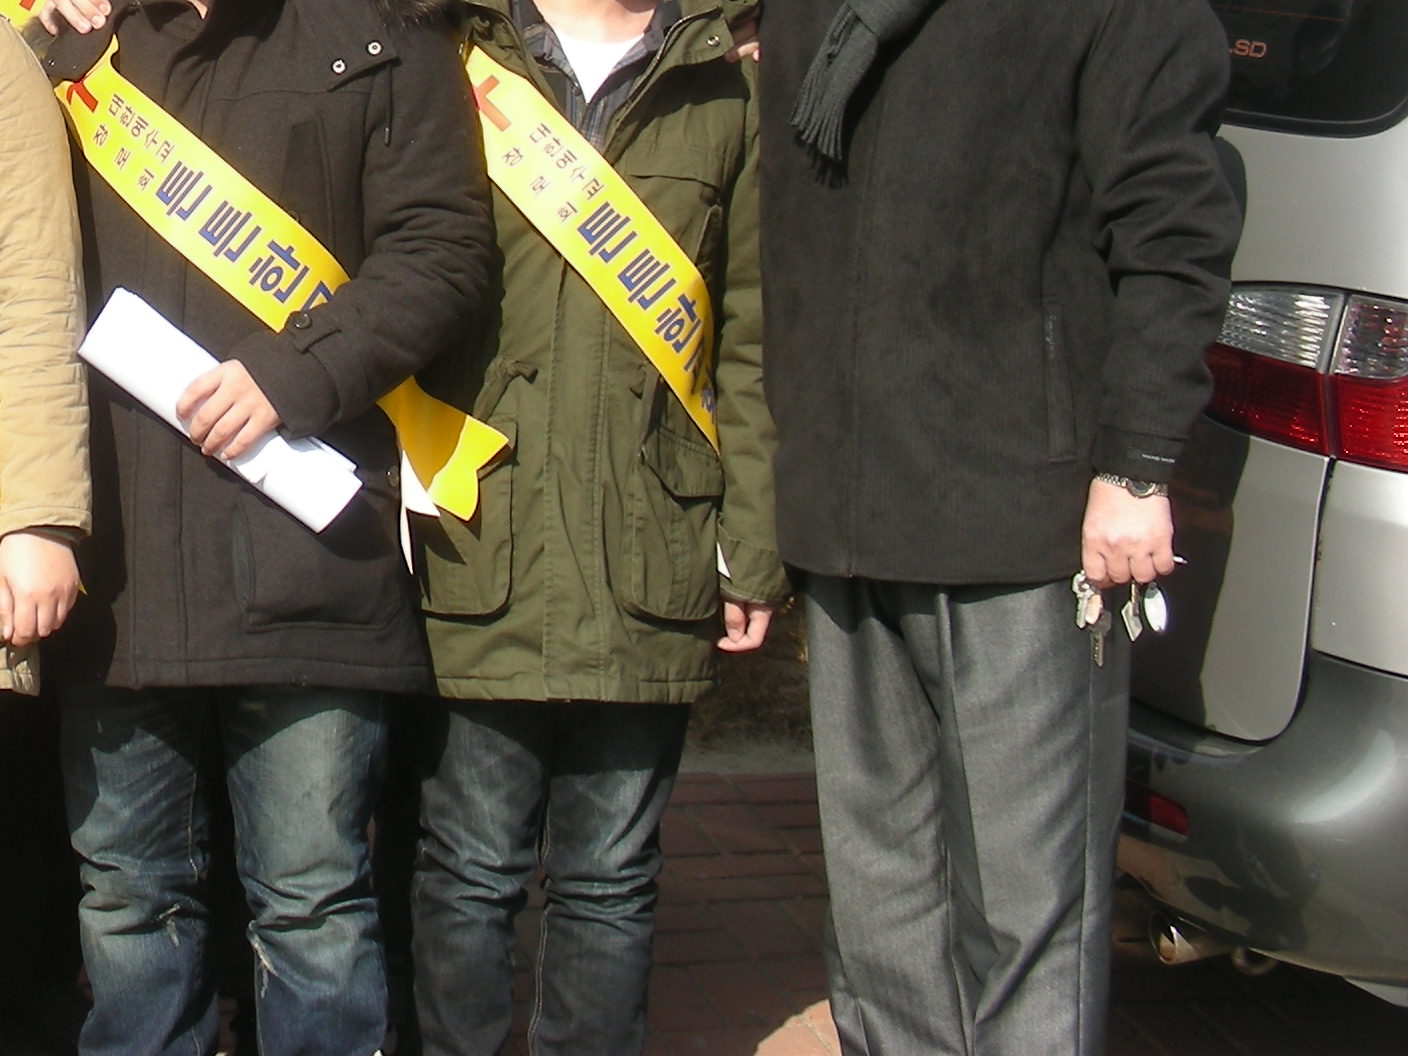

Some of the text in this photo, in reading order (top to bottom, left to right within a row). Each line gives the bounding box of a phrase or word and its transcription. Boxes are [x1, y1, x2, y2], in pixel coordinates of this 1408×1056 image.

[1229, 39, 1267, 58] SD
[109, 93, 175, 163] 대한예수교
[529, 122, 605, 201] 대한예수교
